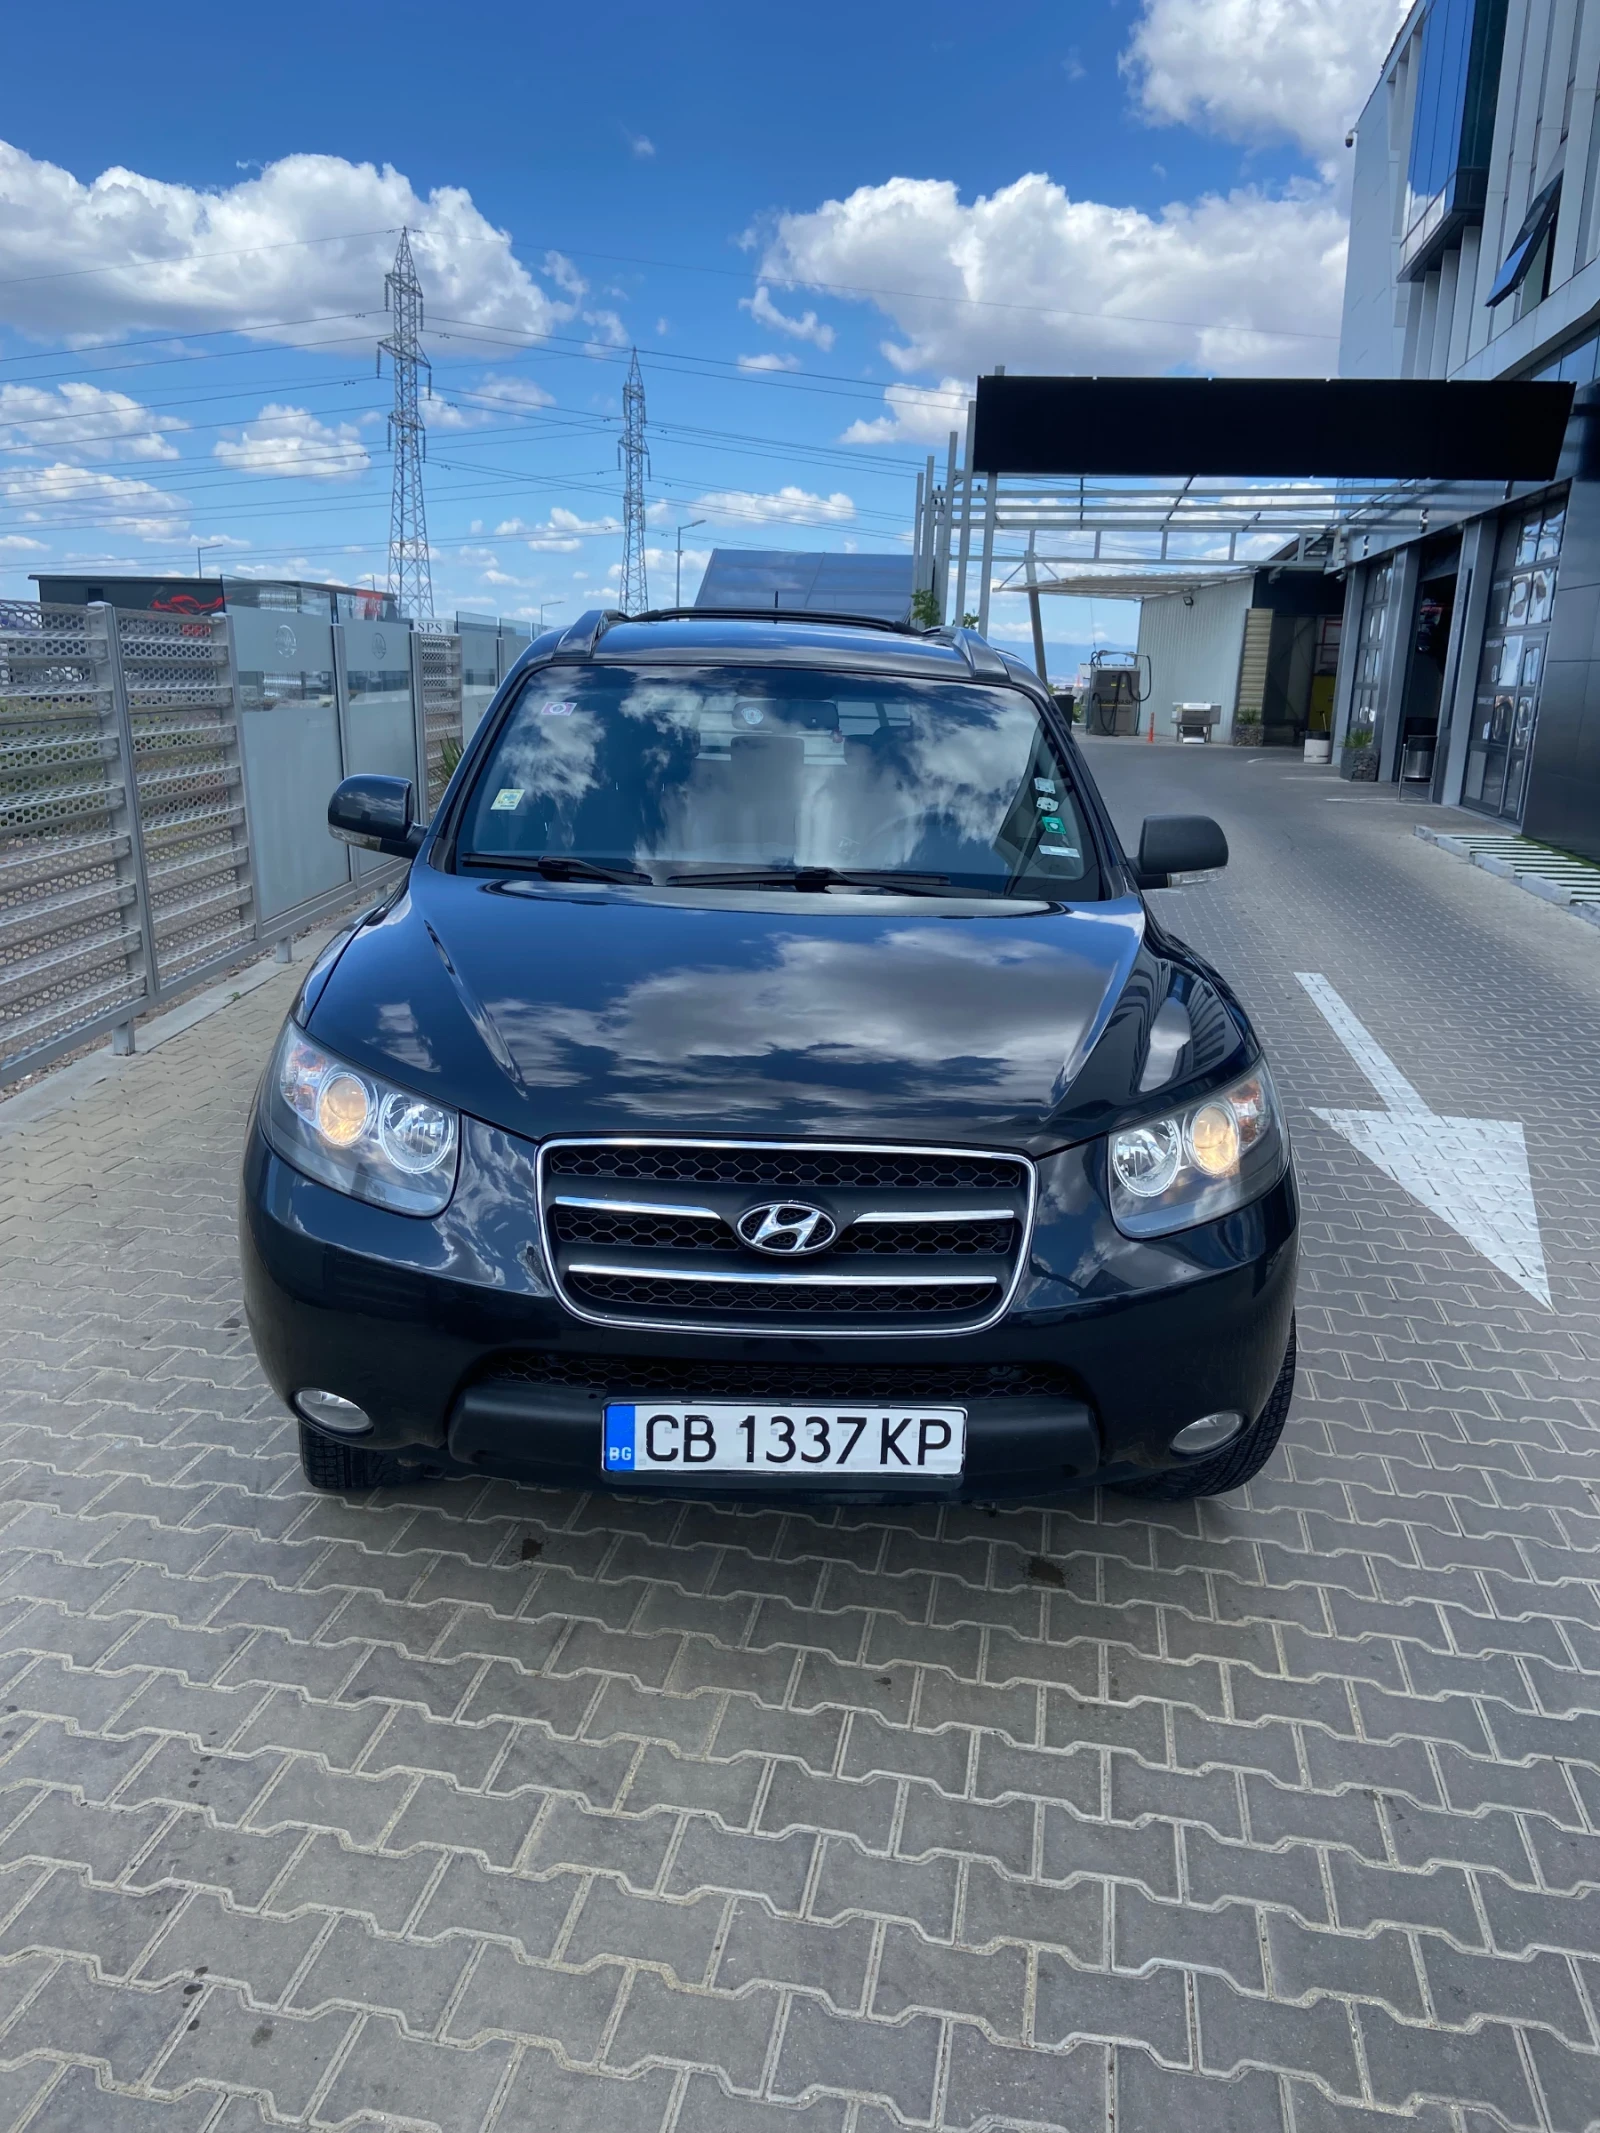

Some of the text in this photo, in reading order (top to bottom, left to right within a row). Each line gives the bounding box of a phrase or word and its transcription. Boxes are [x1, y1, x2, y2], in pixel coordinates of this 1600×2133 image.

[417, 622, 443, 634] SPS
[646, 1414, 951, 1466] CB 1337 KP
[609, 1446, 632, 1461] BG
